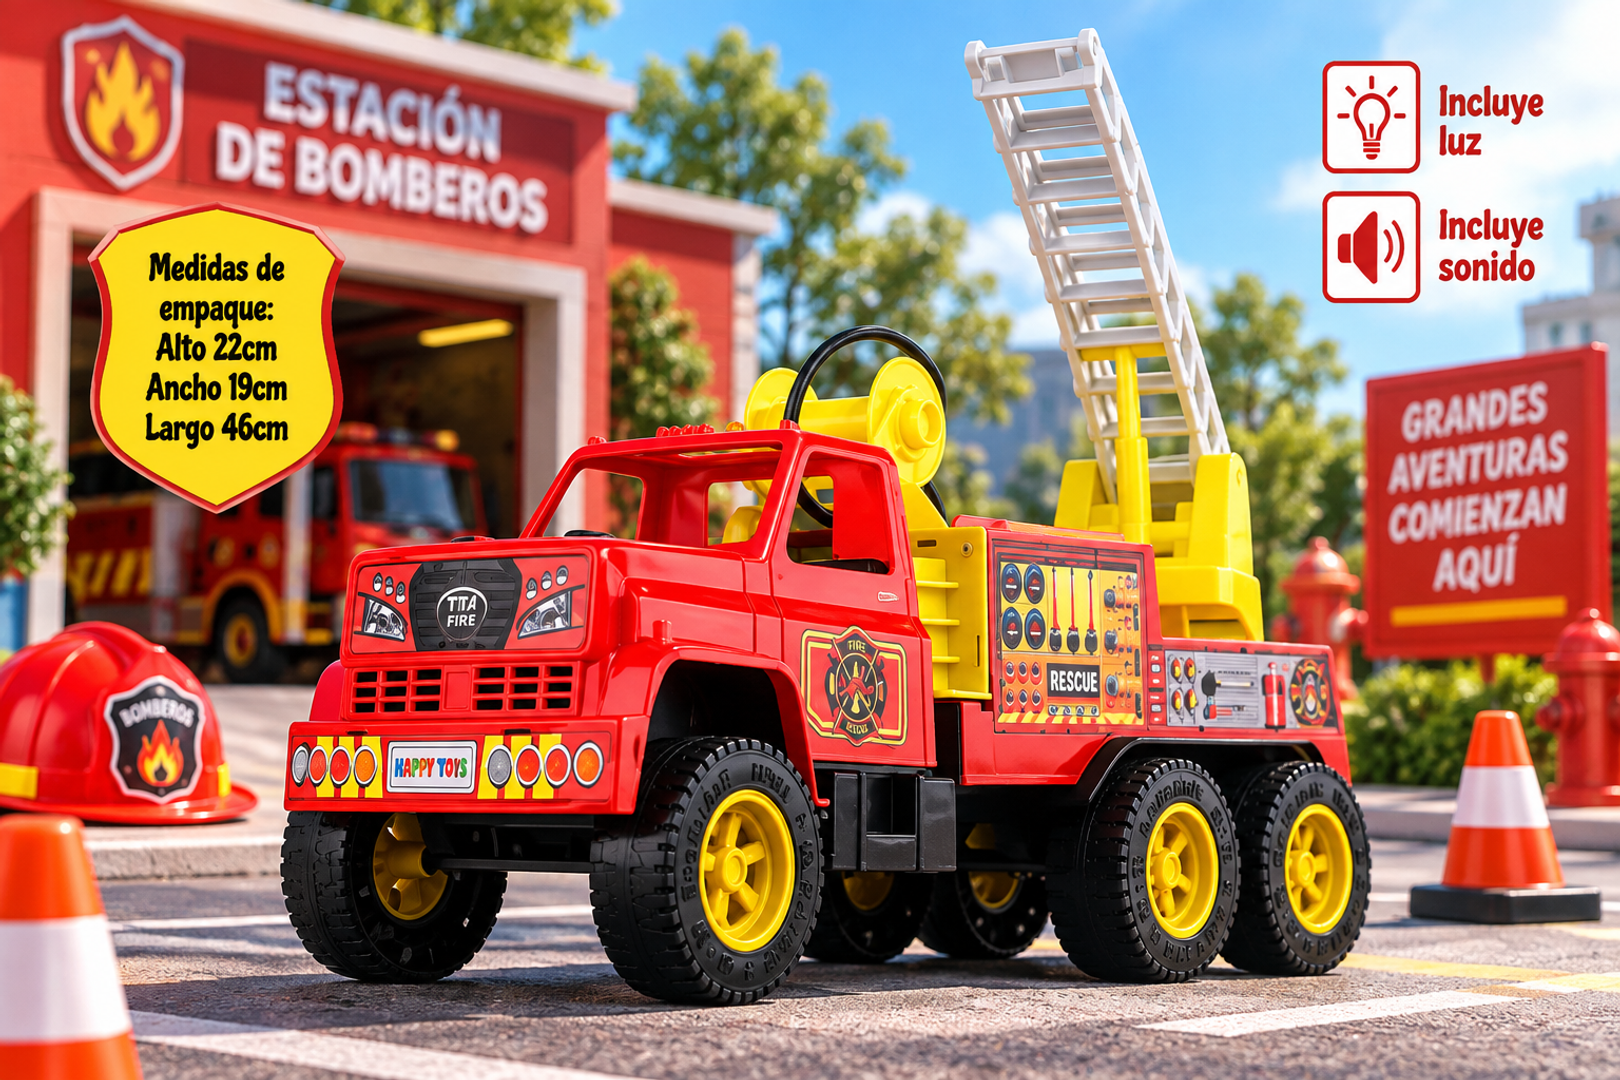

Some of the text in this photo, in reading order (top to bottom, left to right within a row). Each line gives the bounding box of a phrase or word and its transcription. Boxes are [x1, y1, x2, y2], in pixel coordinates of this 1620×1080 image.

[264, 61, 501, 163] ESTACIÓN
[216, 121, 548, 234] DE BOMBEROS
[1402, 381, 1548, 443] GRANDES
[1387, 430, 1568, 495] AVENTURAS
[1388, 482, 1567, 544] COMIENZAN
[1433, 531, 1520, 593] AQUÍ
[447, 614, 476, 627] FIRE
[1050, 669, 1098, 692] RESCUE
[394, 757, 468, 778] HAPPY TOYS
